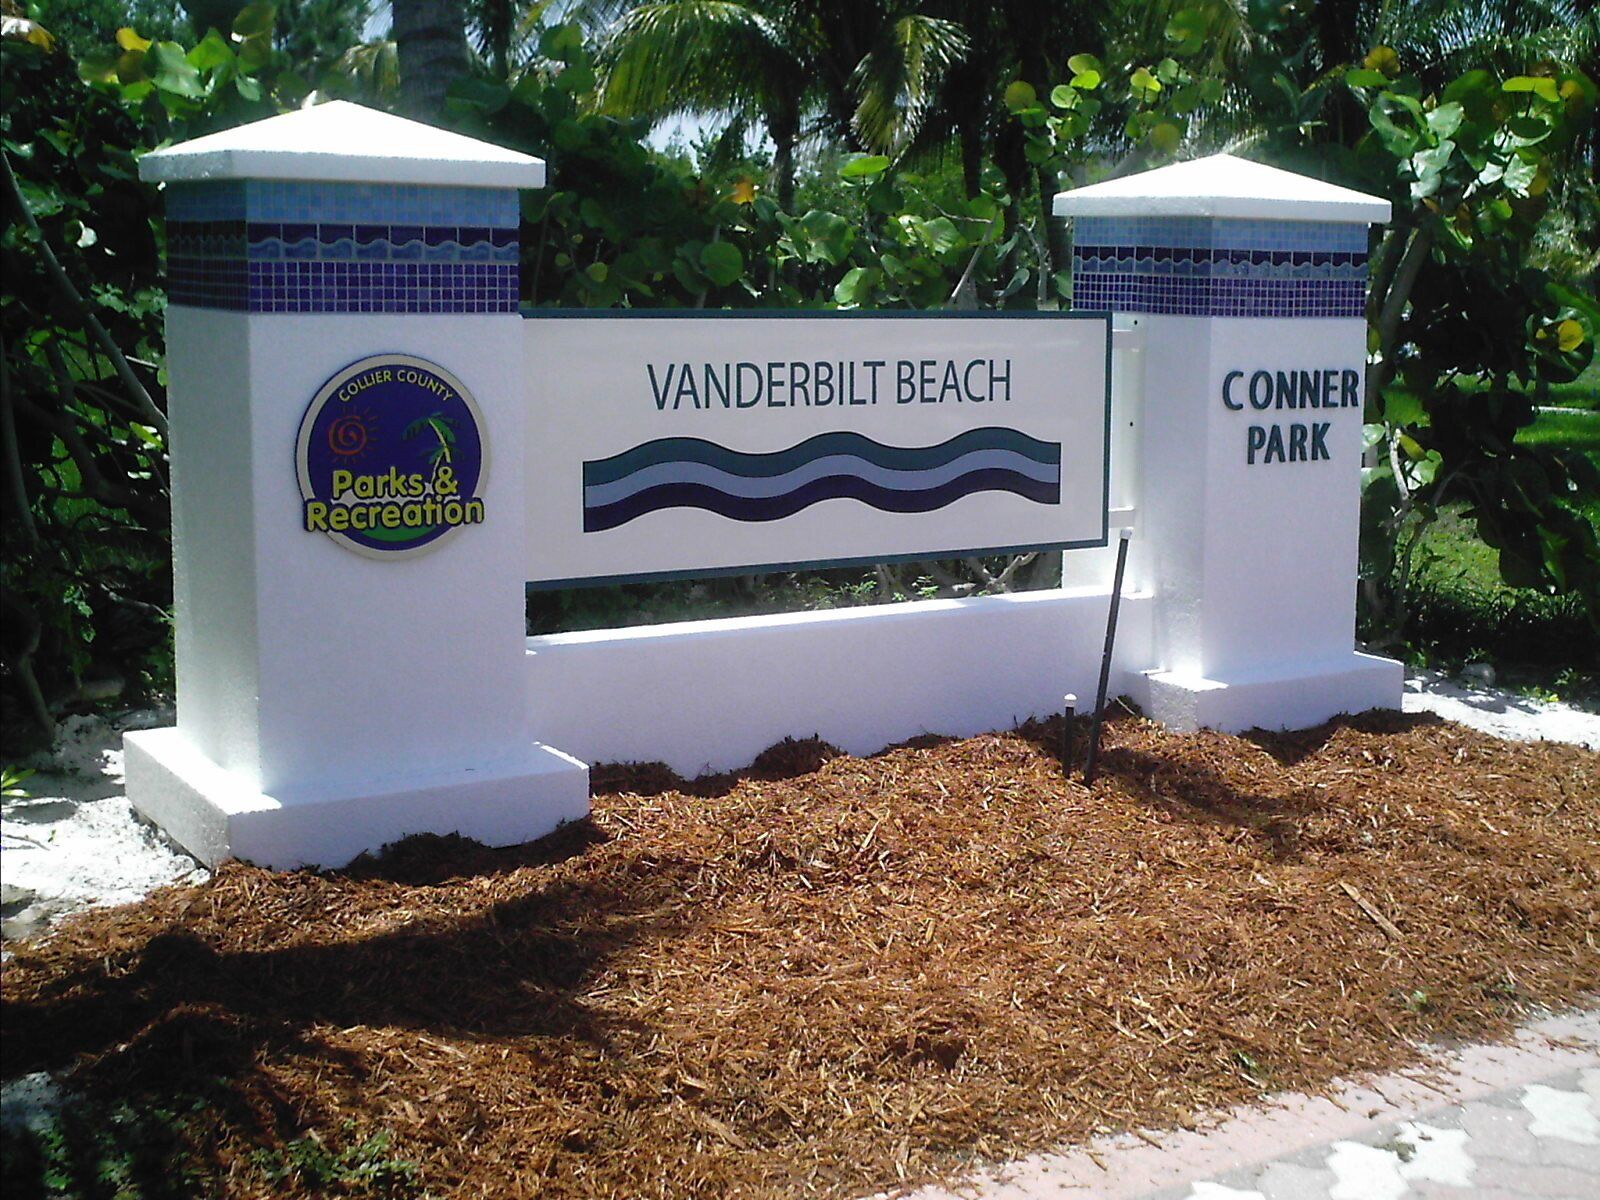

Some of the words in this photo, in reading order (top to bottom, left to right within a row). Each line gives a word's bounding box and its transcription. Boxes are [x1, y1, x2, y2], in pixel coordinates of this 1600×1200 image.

[338, 369, 392, 402] COLLIER
[397, 369, 453, 401] COUNTY
[647, 361, 886, 410] VANDERBILT
[896, 359, 1012, 404] BEACH
[1222, 370, 1360, 410] CONNER
[1247, 422, 1331, 464] PARK
[332, 465, 425, 499] Parks
[434, 466, 459, 495] &
[305, 495, 484, 532] Recreation
